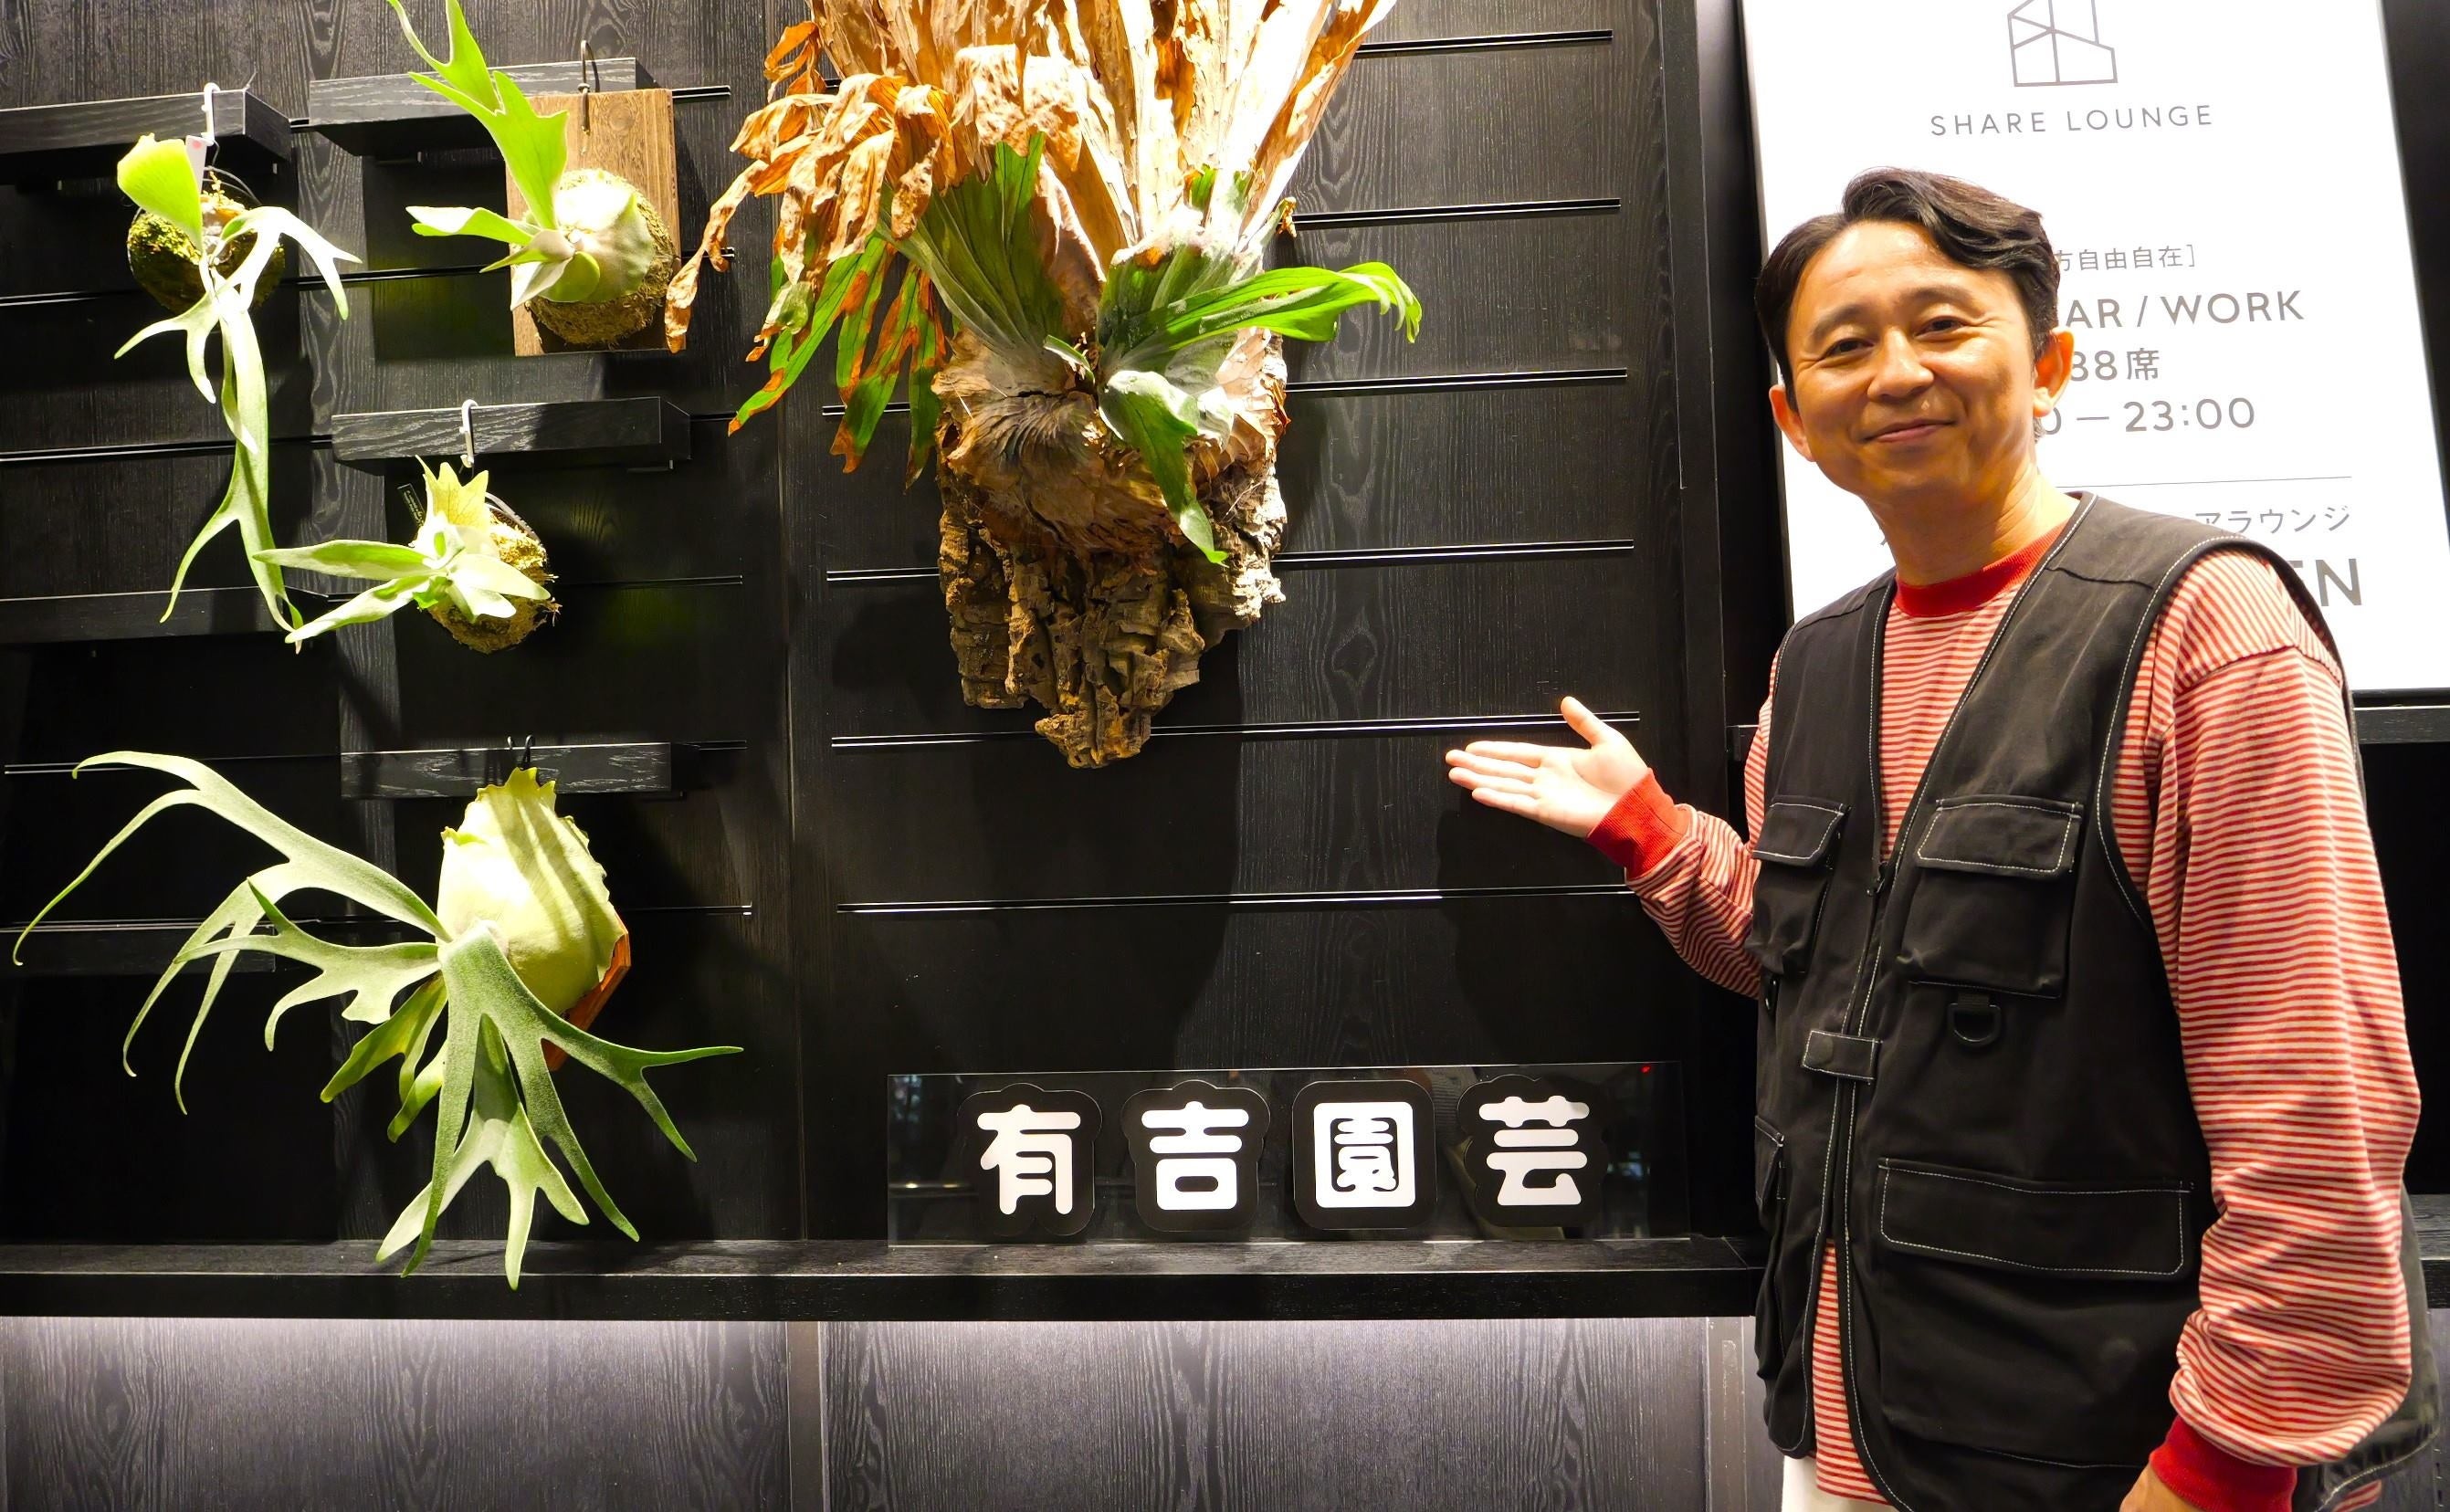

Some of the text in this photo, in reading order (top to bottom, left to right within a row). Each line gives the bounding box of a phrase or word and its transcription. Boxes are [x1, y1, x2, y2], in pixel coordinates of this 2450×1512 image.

[1930, 104, 2213, 137] SHARE LOUNGE
[2160, 289, 2305, 325] WORK
[2123, 397, 2255, 433] 23:00
[977, 1096, 1590, 1214] 有吉園芸
